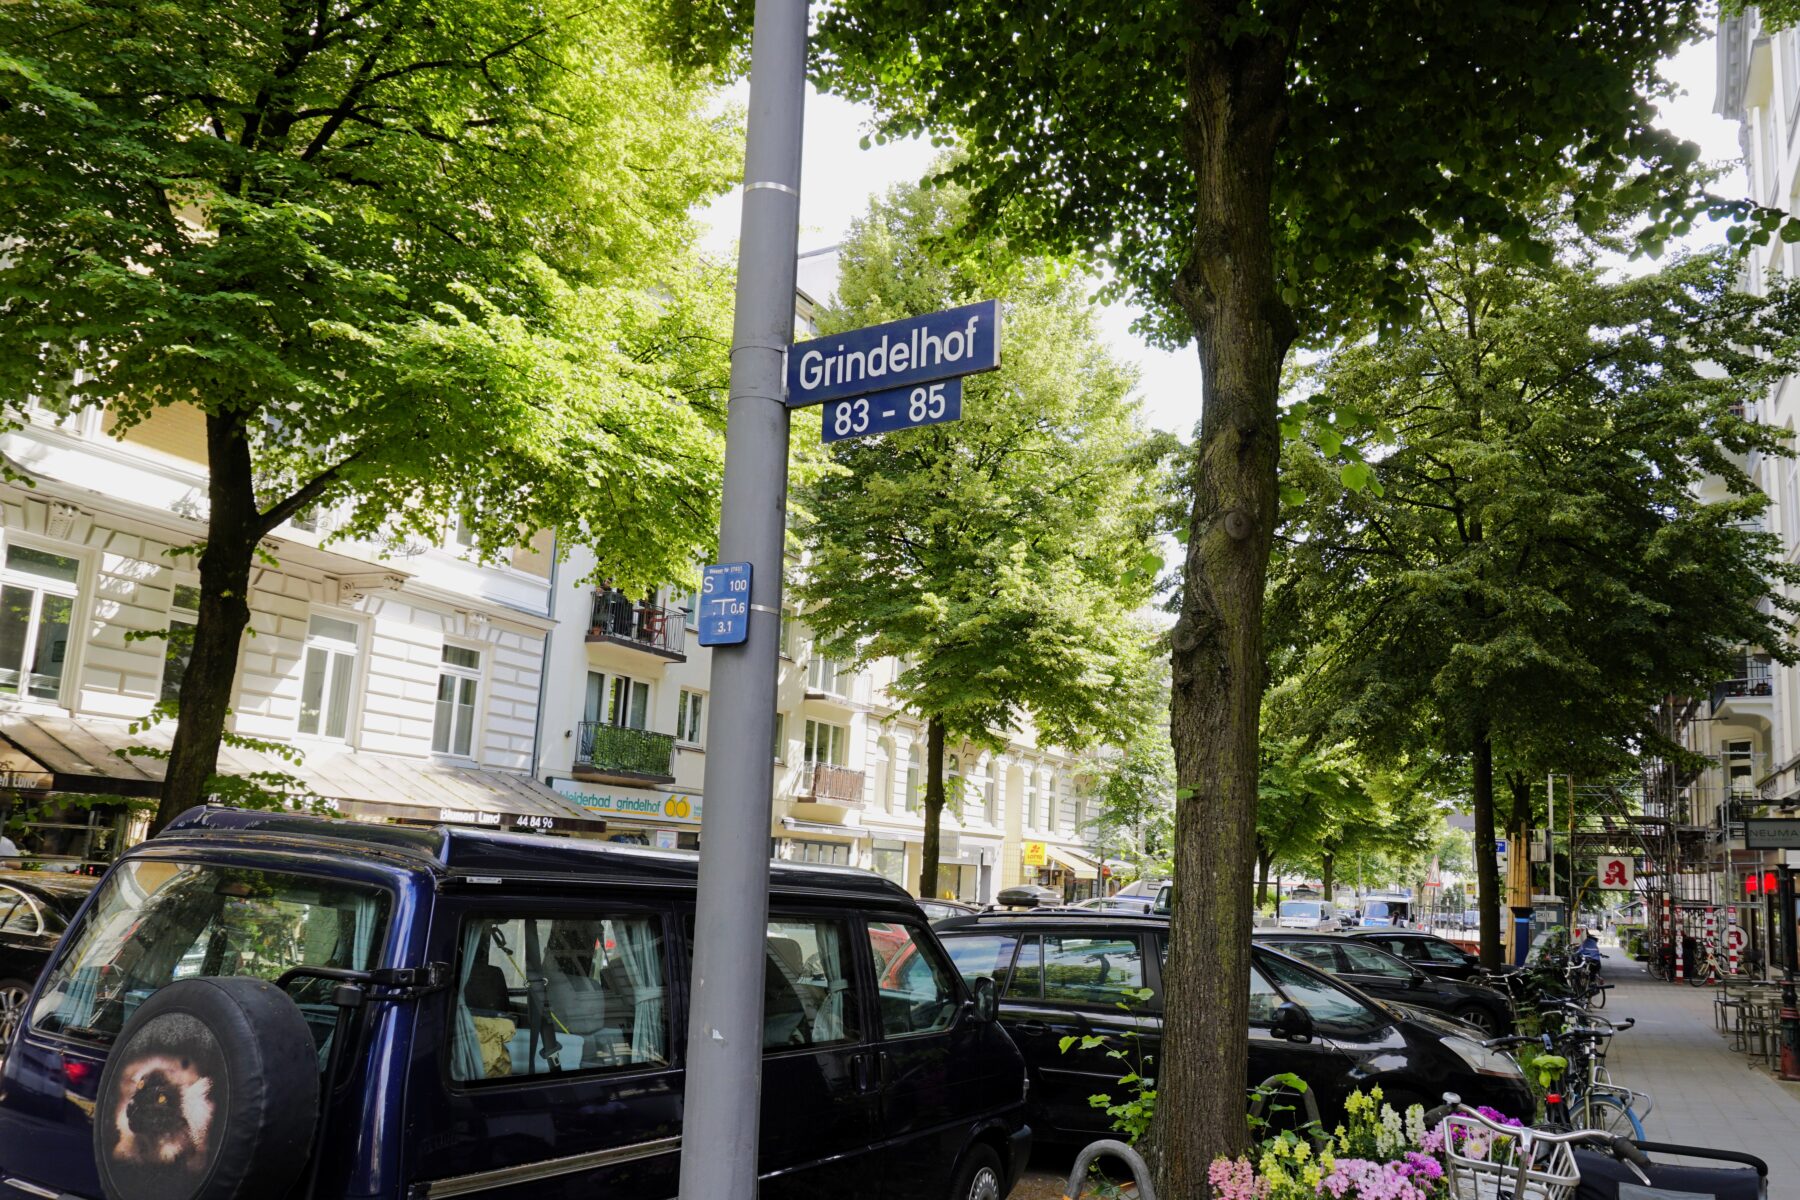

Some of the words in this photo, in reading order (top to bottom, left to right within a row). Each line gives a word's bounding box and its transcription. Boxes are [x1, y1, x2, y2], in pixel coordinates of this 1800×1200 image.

[799, 316, 979, 391] Grindelhof
[834, 398, 870, 436] 83
[882, 408, 896, 418] -
[908, 383, 946, 423] 85
[703, 576, 714, 593] S
[730, 580, 746, 591] 100
[616, 797, 661, 813] grindelhof
[478, 810, 501, 824] Lund
[516, 815, 528, 827] 44
[529, 816, 541, 827] 84
[542, 817, 553, 829] 96
